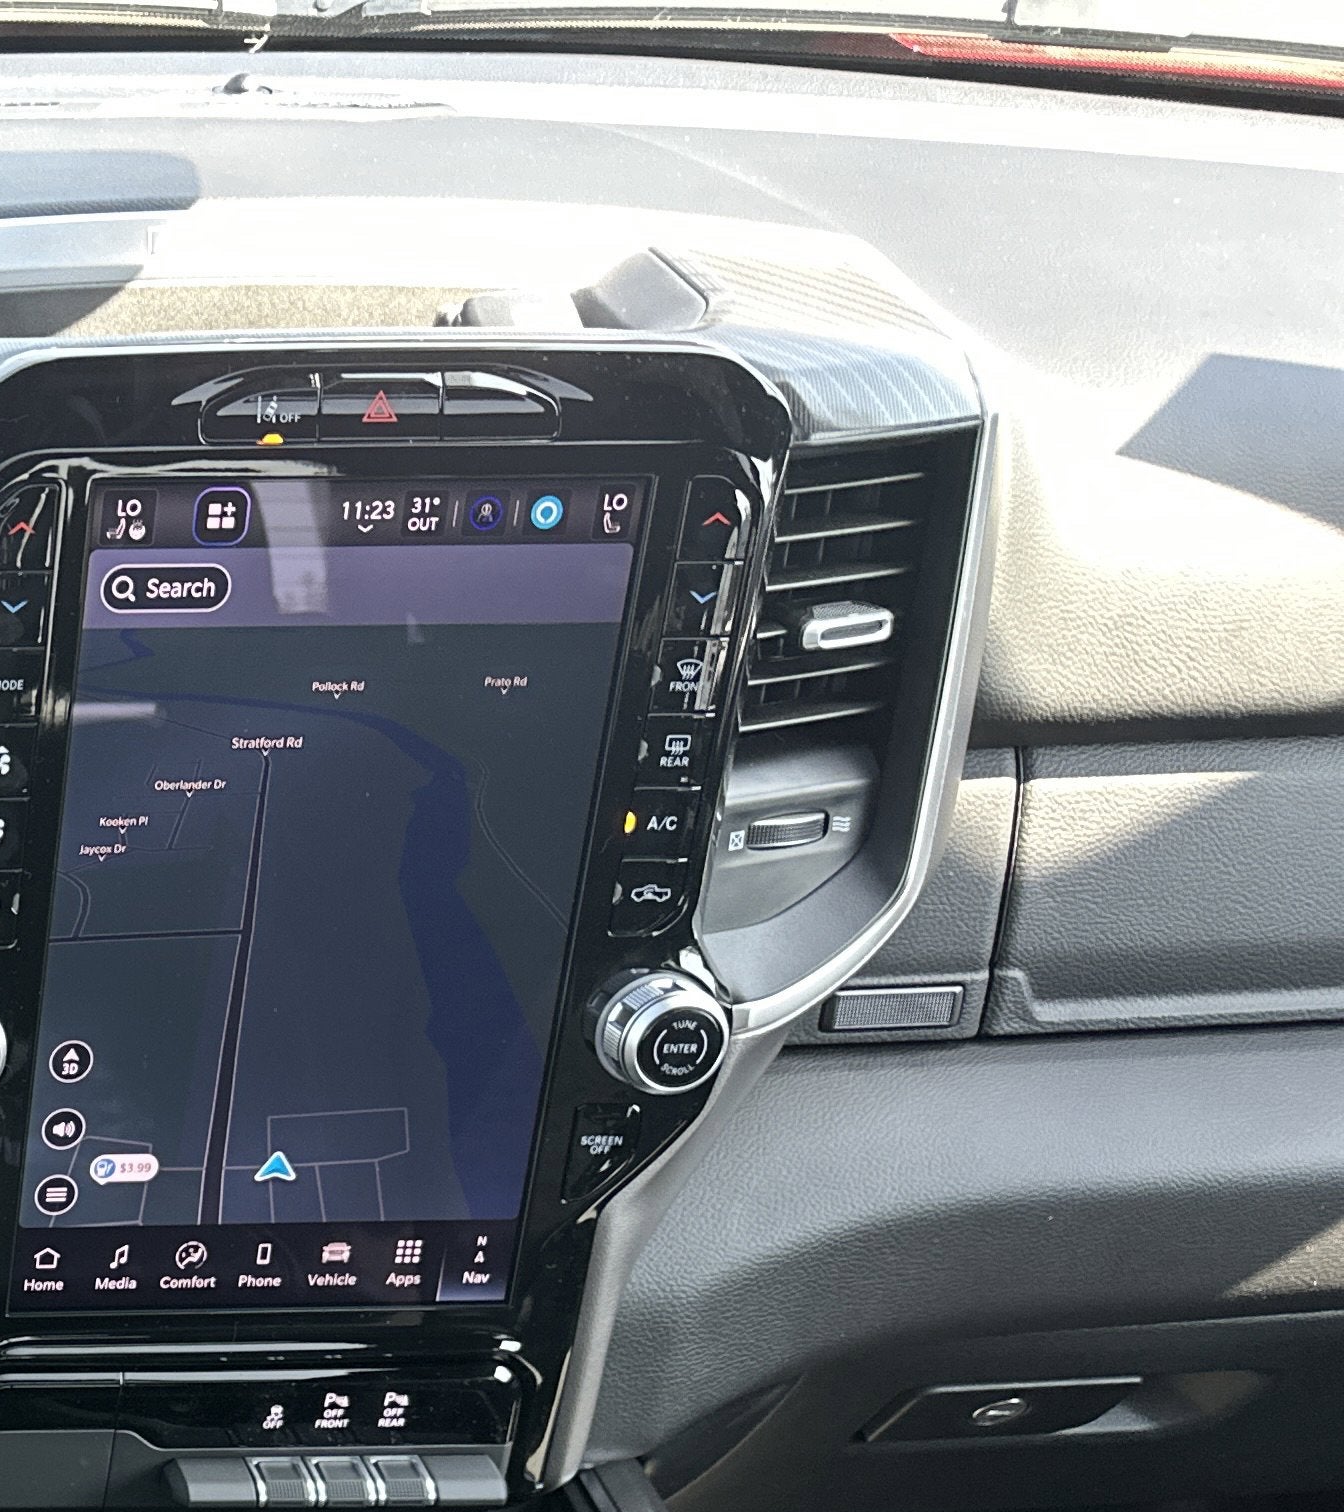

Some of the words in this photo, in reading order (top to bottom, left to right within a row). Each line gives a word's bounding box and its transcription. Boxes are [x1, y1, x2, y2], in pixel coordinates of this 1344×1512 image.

[279, 413, 301, 424] OFF
[116, 499, 141, 517] LO
[603, 493, 628, 511] LO
[342, 501, 395, 521] 11:23
[407, 518, 439, 531] OUT
[146, 577, 215, 600] Search
[312, 681, 348, 692] Pollock
[350, 681, 365, 691] Rd
[484, 677, 511, 688] Prato
[513, 677, 528, 687] Rd
[669, 681, 701, 692] FRON
[231, 736, 283, 750] Stratford
[285, 736, 303, 749] Rd
[659, 756, 690, 768] REAR
[154, 779, 211, 791] Oberlander
[214, 779, 226, 790] Dr
[99, 816, 137, 827] Kooken
[646, 815, 678, 832] A/C
[79, 844, 111, 857] Jaycox
[114, 843, 126, 854] Dr
[672, 1019, 699, 1031] TUNE
[663, 1043, 698, 1054] ENTER
[62, 1062, 79, 1075] 3D
[660, 1063, 695, 1076] SCROLL
[580, 1135, 623, 1146] SCREEN
[590, 1146, 611, 1155] OFF
[119, 1161, 152, 1175] $3.99
[94, 1277, 137, 1290] Media
[159, 1274, 217, 1289] Comfort
[238, 1274, 282, 1288] Phone
[307, 1272, 357, 1287] Vehicle
[386, 1271, 421, 1288] Apps
[462, 1270, 490, 1285] Nav
[23, 1278, 64, 1291] Home
[323, 1409, 345, 1418] OFF
[383, 1408, 404, 1417] OFF
[262, 1420, 283, 1429] OFF
[314, 1418, 349, 1428] FRONT
[377, 1418, 405, 1427] REAR
